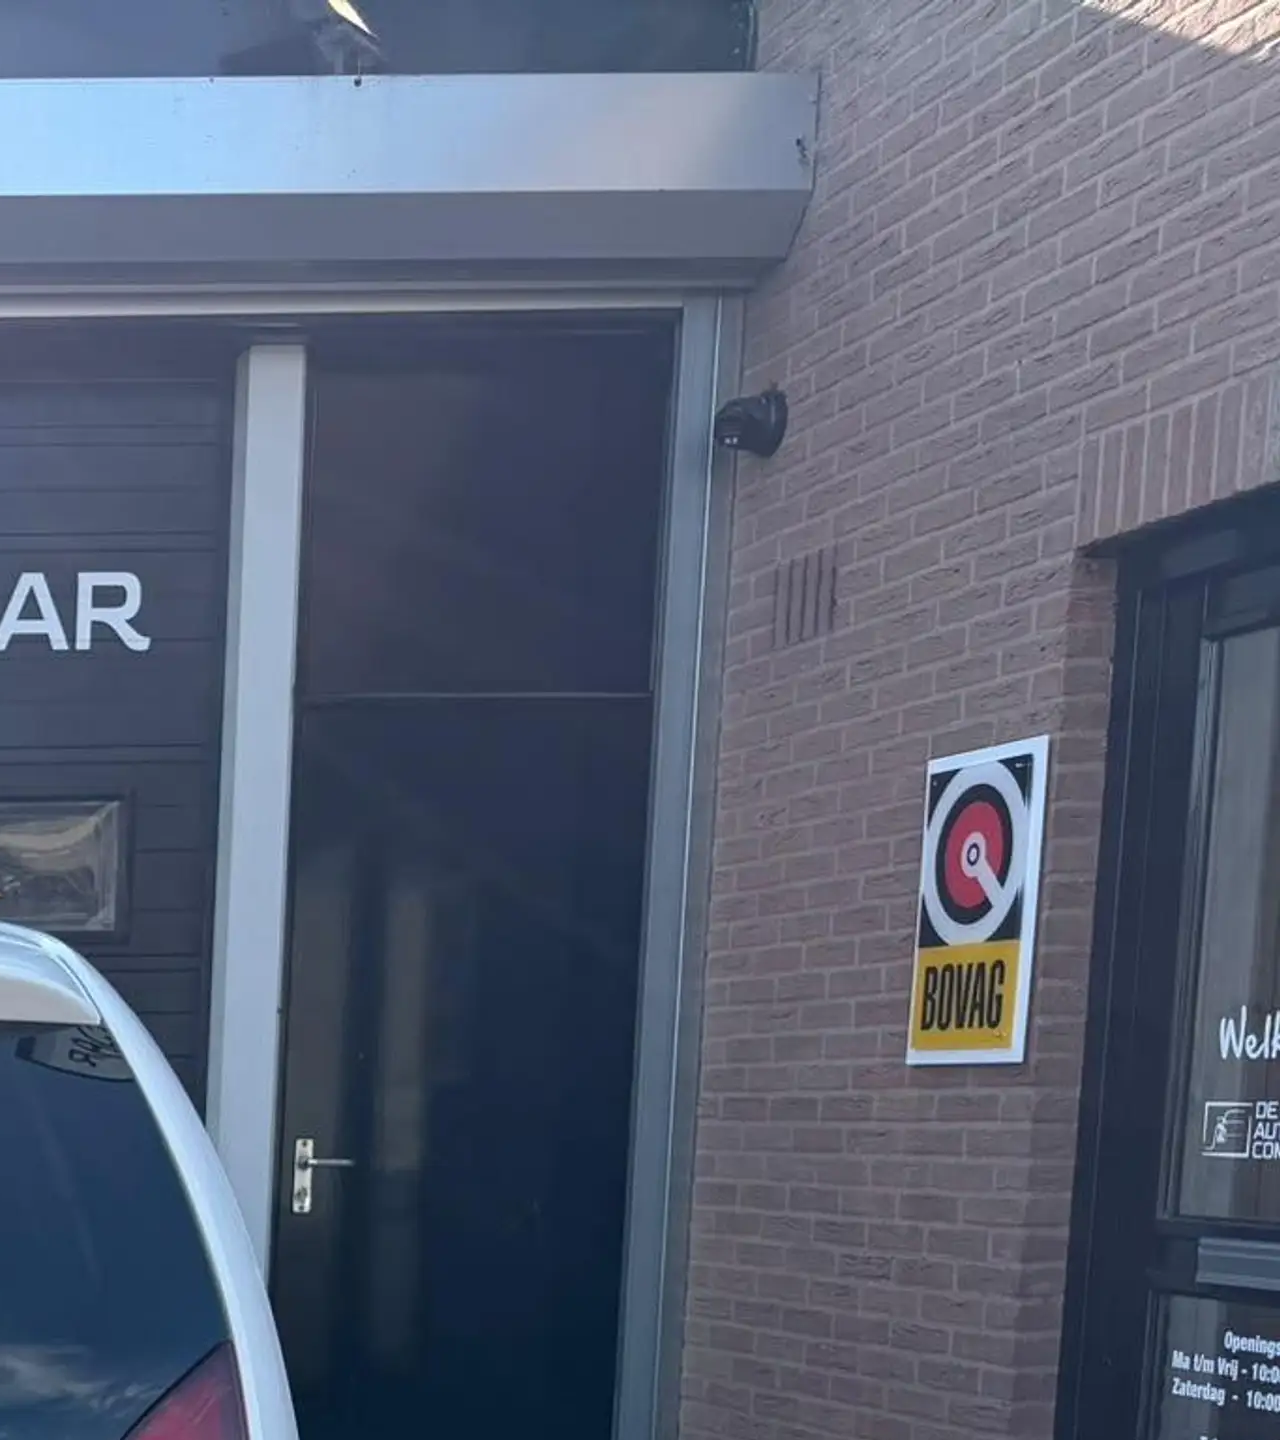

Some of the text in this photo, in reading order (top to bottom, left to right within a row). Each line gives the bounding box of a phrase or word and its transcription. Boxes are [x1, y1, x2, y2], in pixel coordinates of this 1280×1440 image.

[920, 958, 1006, 1032] BOVAG
[1255, 1101, 1280, 1120] DE
[1171, 1349, 1191, 1371] Ma
[1217, 1356, 1239, 1381] Vrij
[1172, 1377, 1225, 1406] Zaterdag
